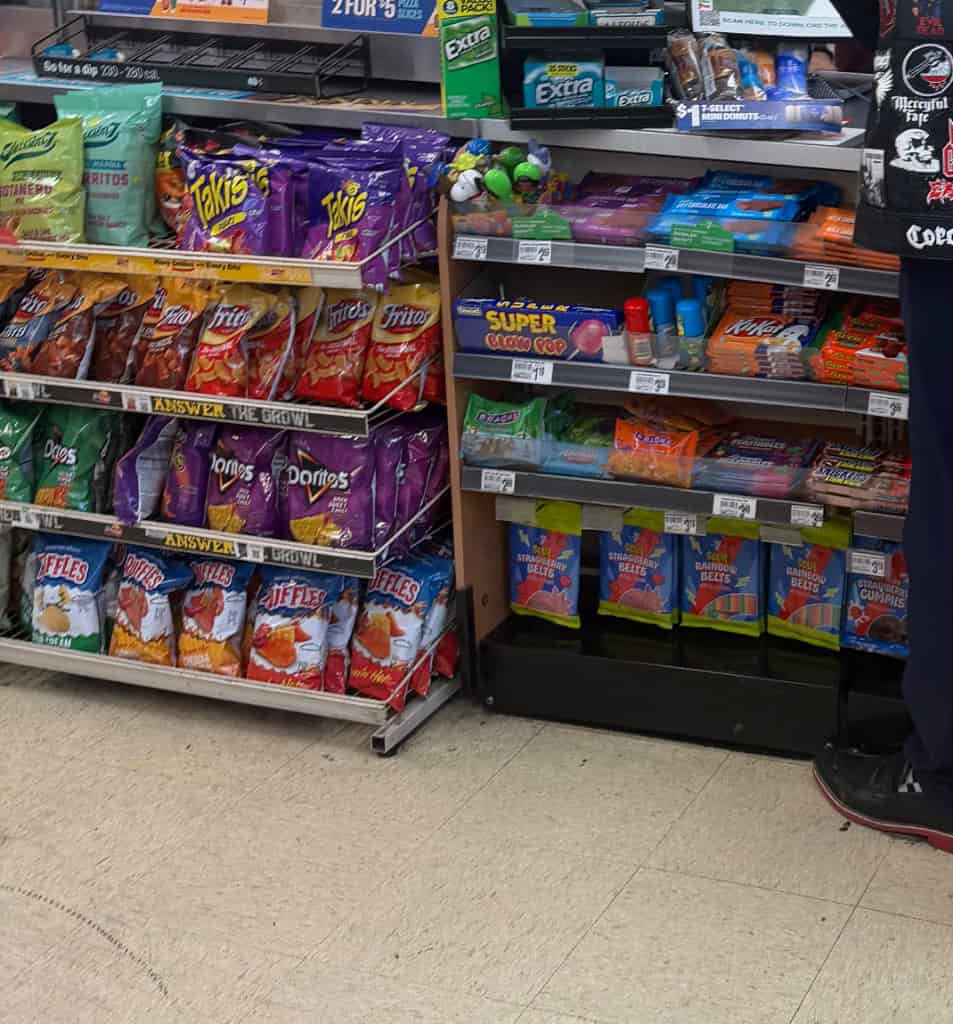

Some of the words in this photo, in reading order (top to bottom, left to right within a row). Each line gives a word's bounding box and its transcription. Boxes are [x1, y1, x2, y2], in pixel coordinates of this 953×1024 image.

[460, 3, 493, 12] PACK!
[445, 26, 492, 62] Extra
[58, 62, 73, 74] for
[74, 65, 81, 74] a
[82, 64, 99, 77] dip
[535, 78, 593, 105] Extra
[618, 91, 652, 106] Extra
[676, 103, 700, 127] $1
[891, 96, 949, 113] Mercyful
[724, 112, 759, 121] DONUTS
[190, 171, 249, 229] Takis
[321, 191, 368, 238] Takis
[382, 303, 432, 330] Fritos
[485, 310, 557, 335] SUPER
[485, 333, 533, 352] BLOW
[533, 335, 568, 356] POP
[154, 397, 225, 418] ANSWER
[231, 406, 258, 421] THE
[262, 408, 316, 428] GROWL
[287, 464, 349, 490] Doritos
[164, 532, 234, 554] ANSWER
[271, 549, 323, 567] GROWL
[527, 563, 555, 579] BELTS
[618, 562, 648, 577] BELTS
[700, 571, 731, 584] BELTS
[791, 577, 820, 593] BELTS
